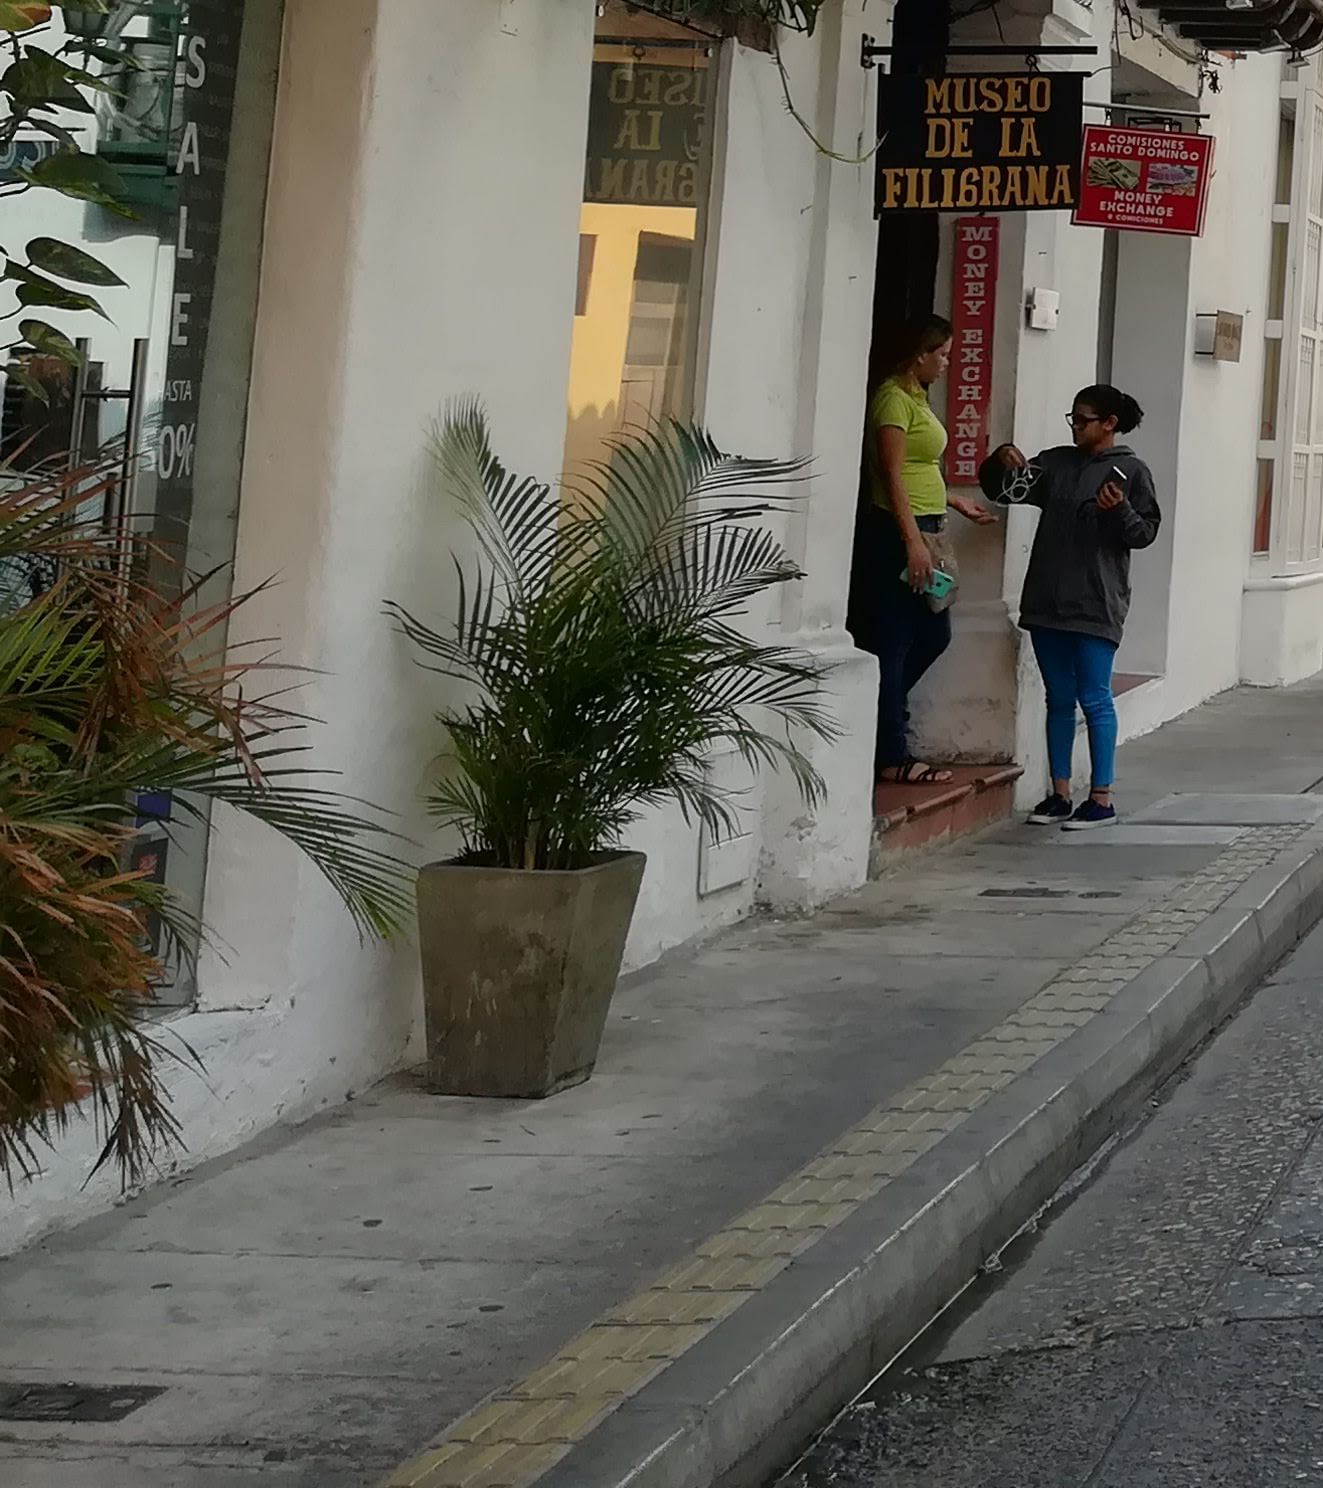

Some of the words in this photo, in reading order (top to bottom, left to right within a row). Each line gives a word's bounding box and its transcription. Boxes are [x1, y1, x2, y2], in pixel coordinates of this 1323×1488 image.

[924, 77, 1052, 114] MUSEO
[925, 117, 974, 158] DE
[998, 116, 1041, 157] LA
[1090, 142, 1133, 155] SANTO
[1137, 146, 1200, 161] DOMINGO
[1108, 134, 1185, 150] COMISIONES
[171, 36, 206, 346] SALE
[882, 164, 1074, 209] FILIGRANA
[1114, 191, 1162, 205] MONEY
[1099, 201, 1174, 217] EXCHANGE
[961, 226, 993, 315] MONEY
[161, 379, 192, 401] ASTA
[954, 329, 984, 477] EXCHANGE
